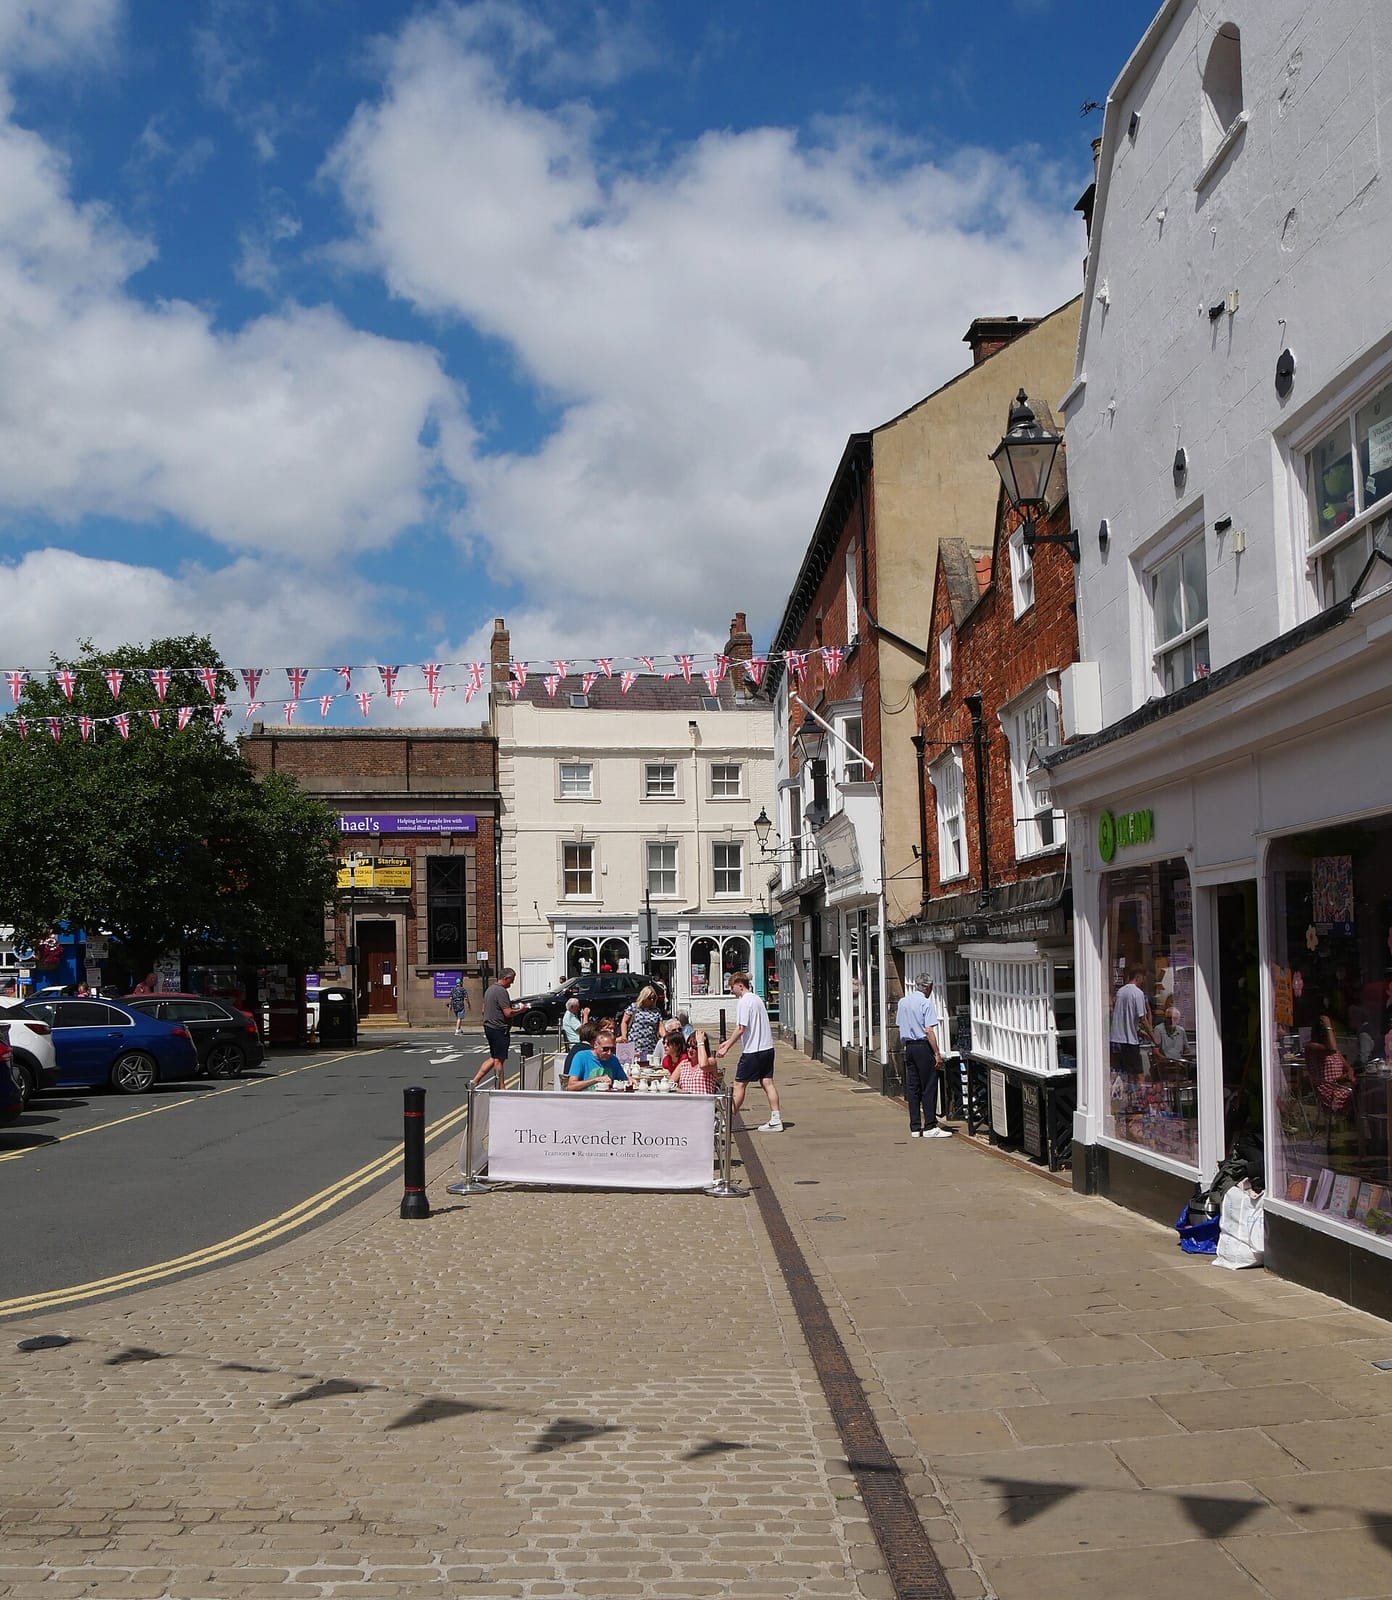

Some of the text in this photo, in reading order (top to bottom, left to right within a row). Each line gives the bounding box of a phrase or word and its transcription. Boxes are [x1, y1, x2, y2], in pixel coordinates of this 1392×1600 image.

[378, 858, 407, 866] Starkeys
[514, 1129, 688, 1147] The Lavender Rooms
[637, 1151, 660, 1159] Lounge
